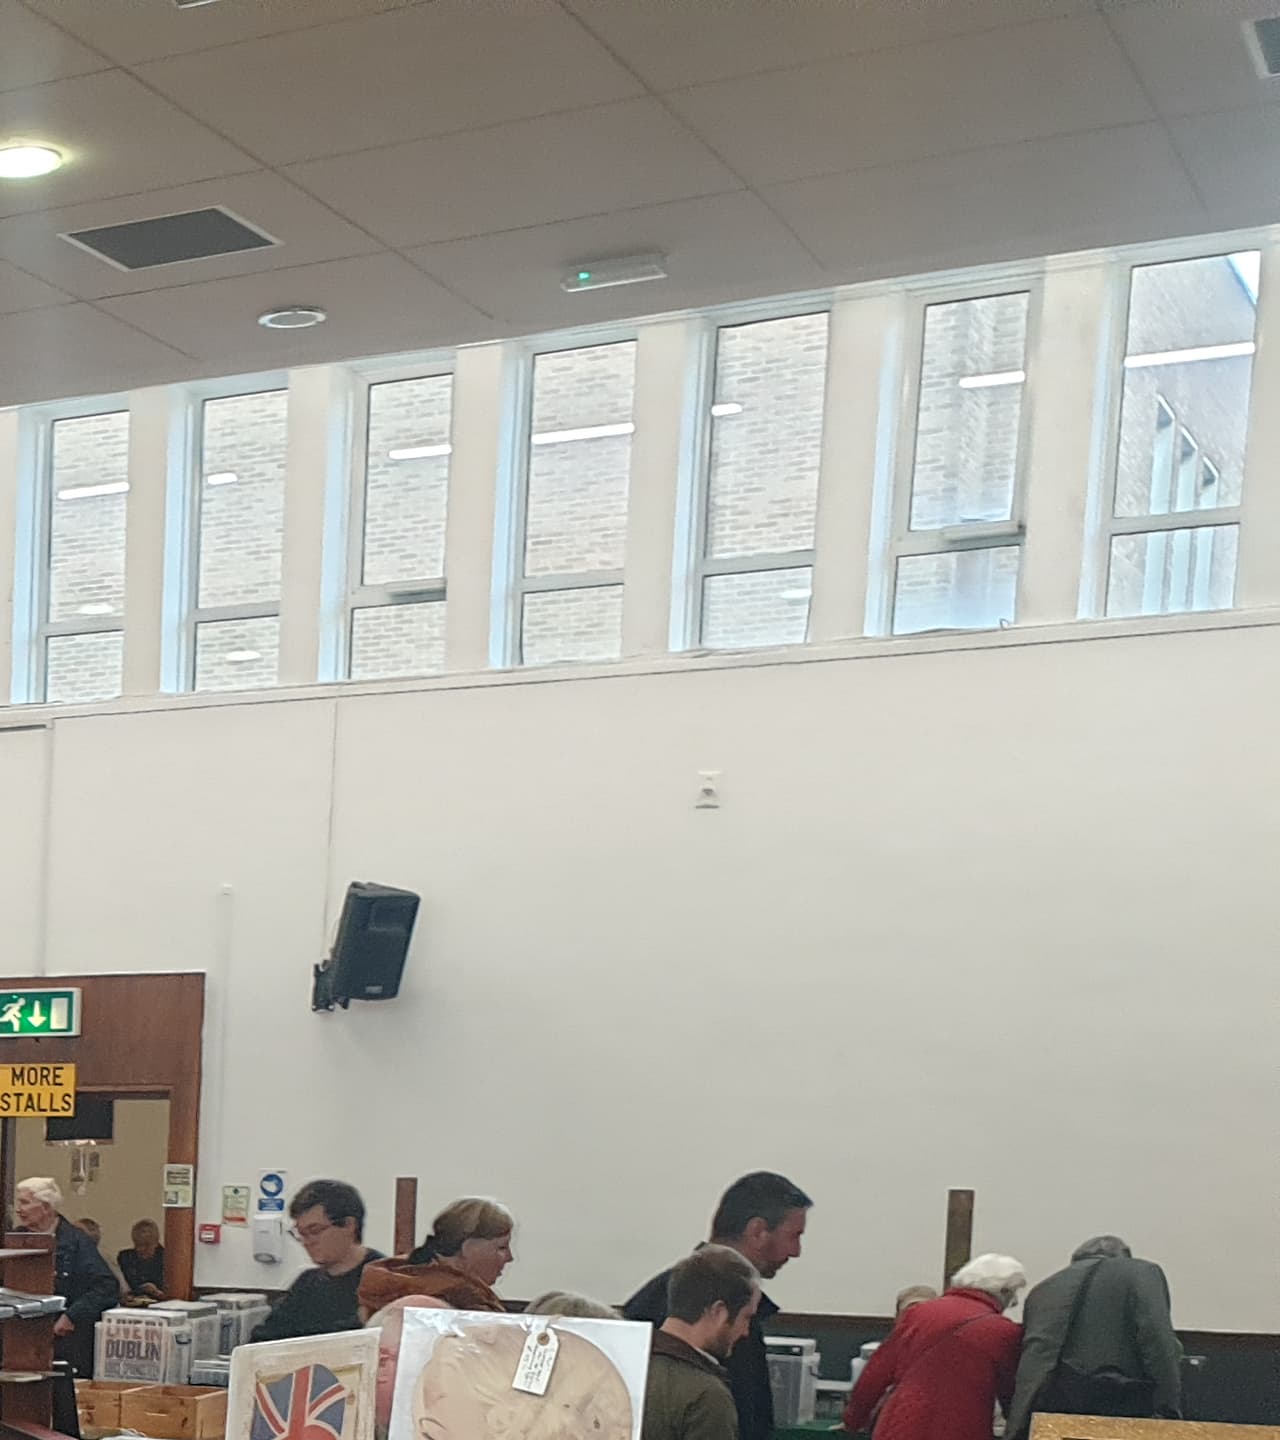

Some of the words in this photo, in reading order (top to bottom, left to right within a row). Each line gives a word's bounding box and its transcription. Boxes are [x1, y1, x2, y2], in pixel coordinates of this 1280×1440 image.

[11, 1067, 64, 1087] MORE
[0, 1092, 73, 1113] STALLS
[106, 1327, 142, 1340] LIVE
[144, 1328, 162, 1342] IN
[105, 1339, 162, 1361] DUBLIN
